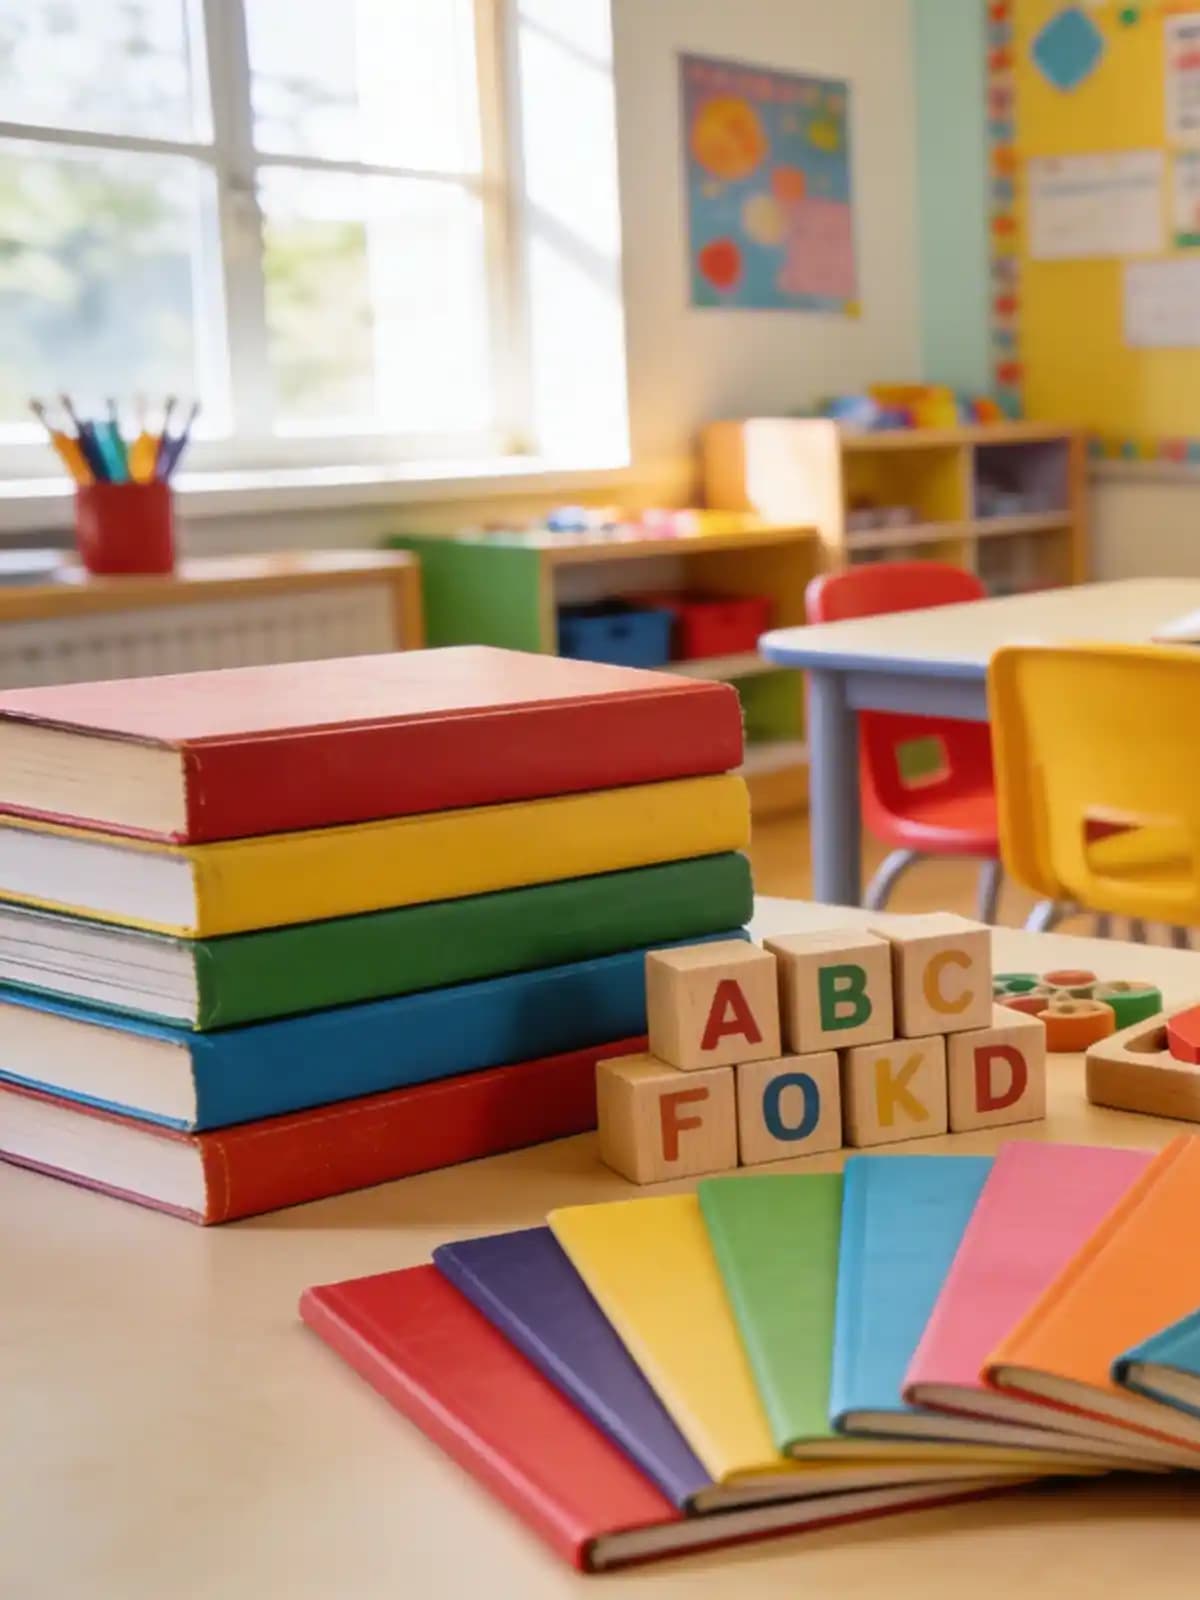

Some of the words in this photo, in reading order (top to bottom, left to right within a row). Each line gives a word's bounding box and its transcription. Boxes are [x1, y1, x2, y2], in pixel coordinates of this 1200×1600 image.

[700, 979, 762, 1050] A
[818, 964, 872, 1031] B
[923, 949, 974, 1015] C
[763, 1072, 820, 1142] O
[874, 1053, 930, 1127] K
[974, 1044, 1028, 1113] D
[659, 1087, 709, 1162] F
